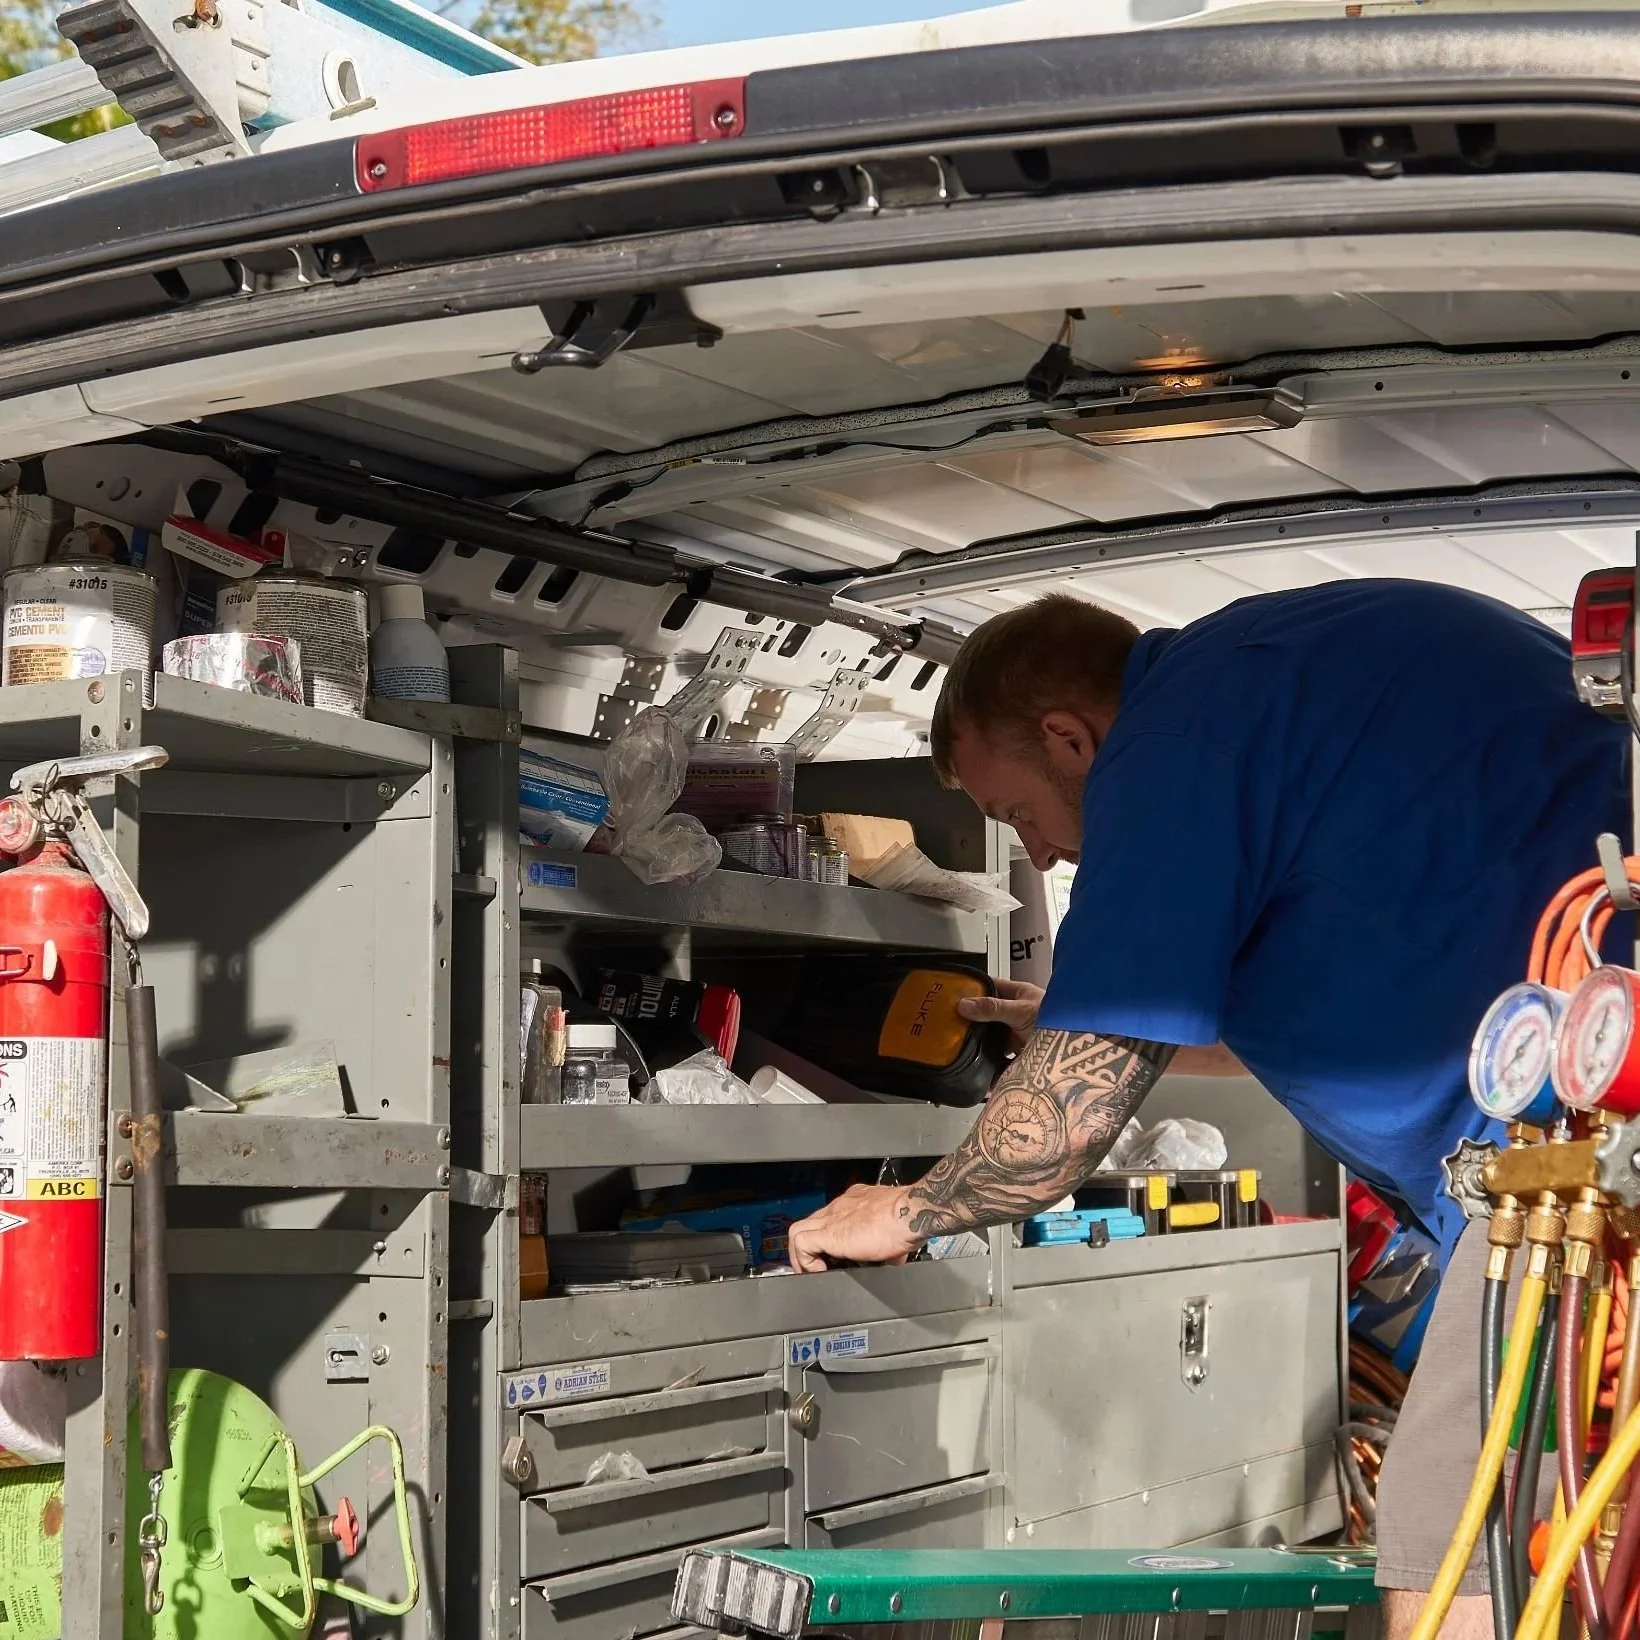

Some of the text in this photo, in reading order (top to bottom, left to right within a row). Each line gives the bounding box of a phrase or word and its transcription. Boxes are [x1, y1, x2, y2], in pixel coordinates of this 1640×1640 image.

[69, 578, 107, 590] #31015
[10, 606, 65, 618] PVC CEMENT
[8, 624, 45, 637] CEMENTO
[910, 982, 944, 1036] FLUKE
[40, 1182, 85, 1196] ABC
[564, 1372, 608, 1388] ADRIAN STEEL
